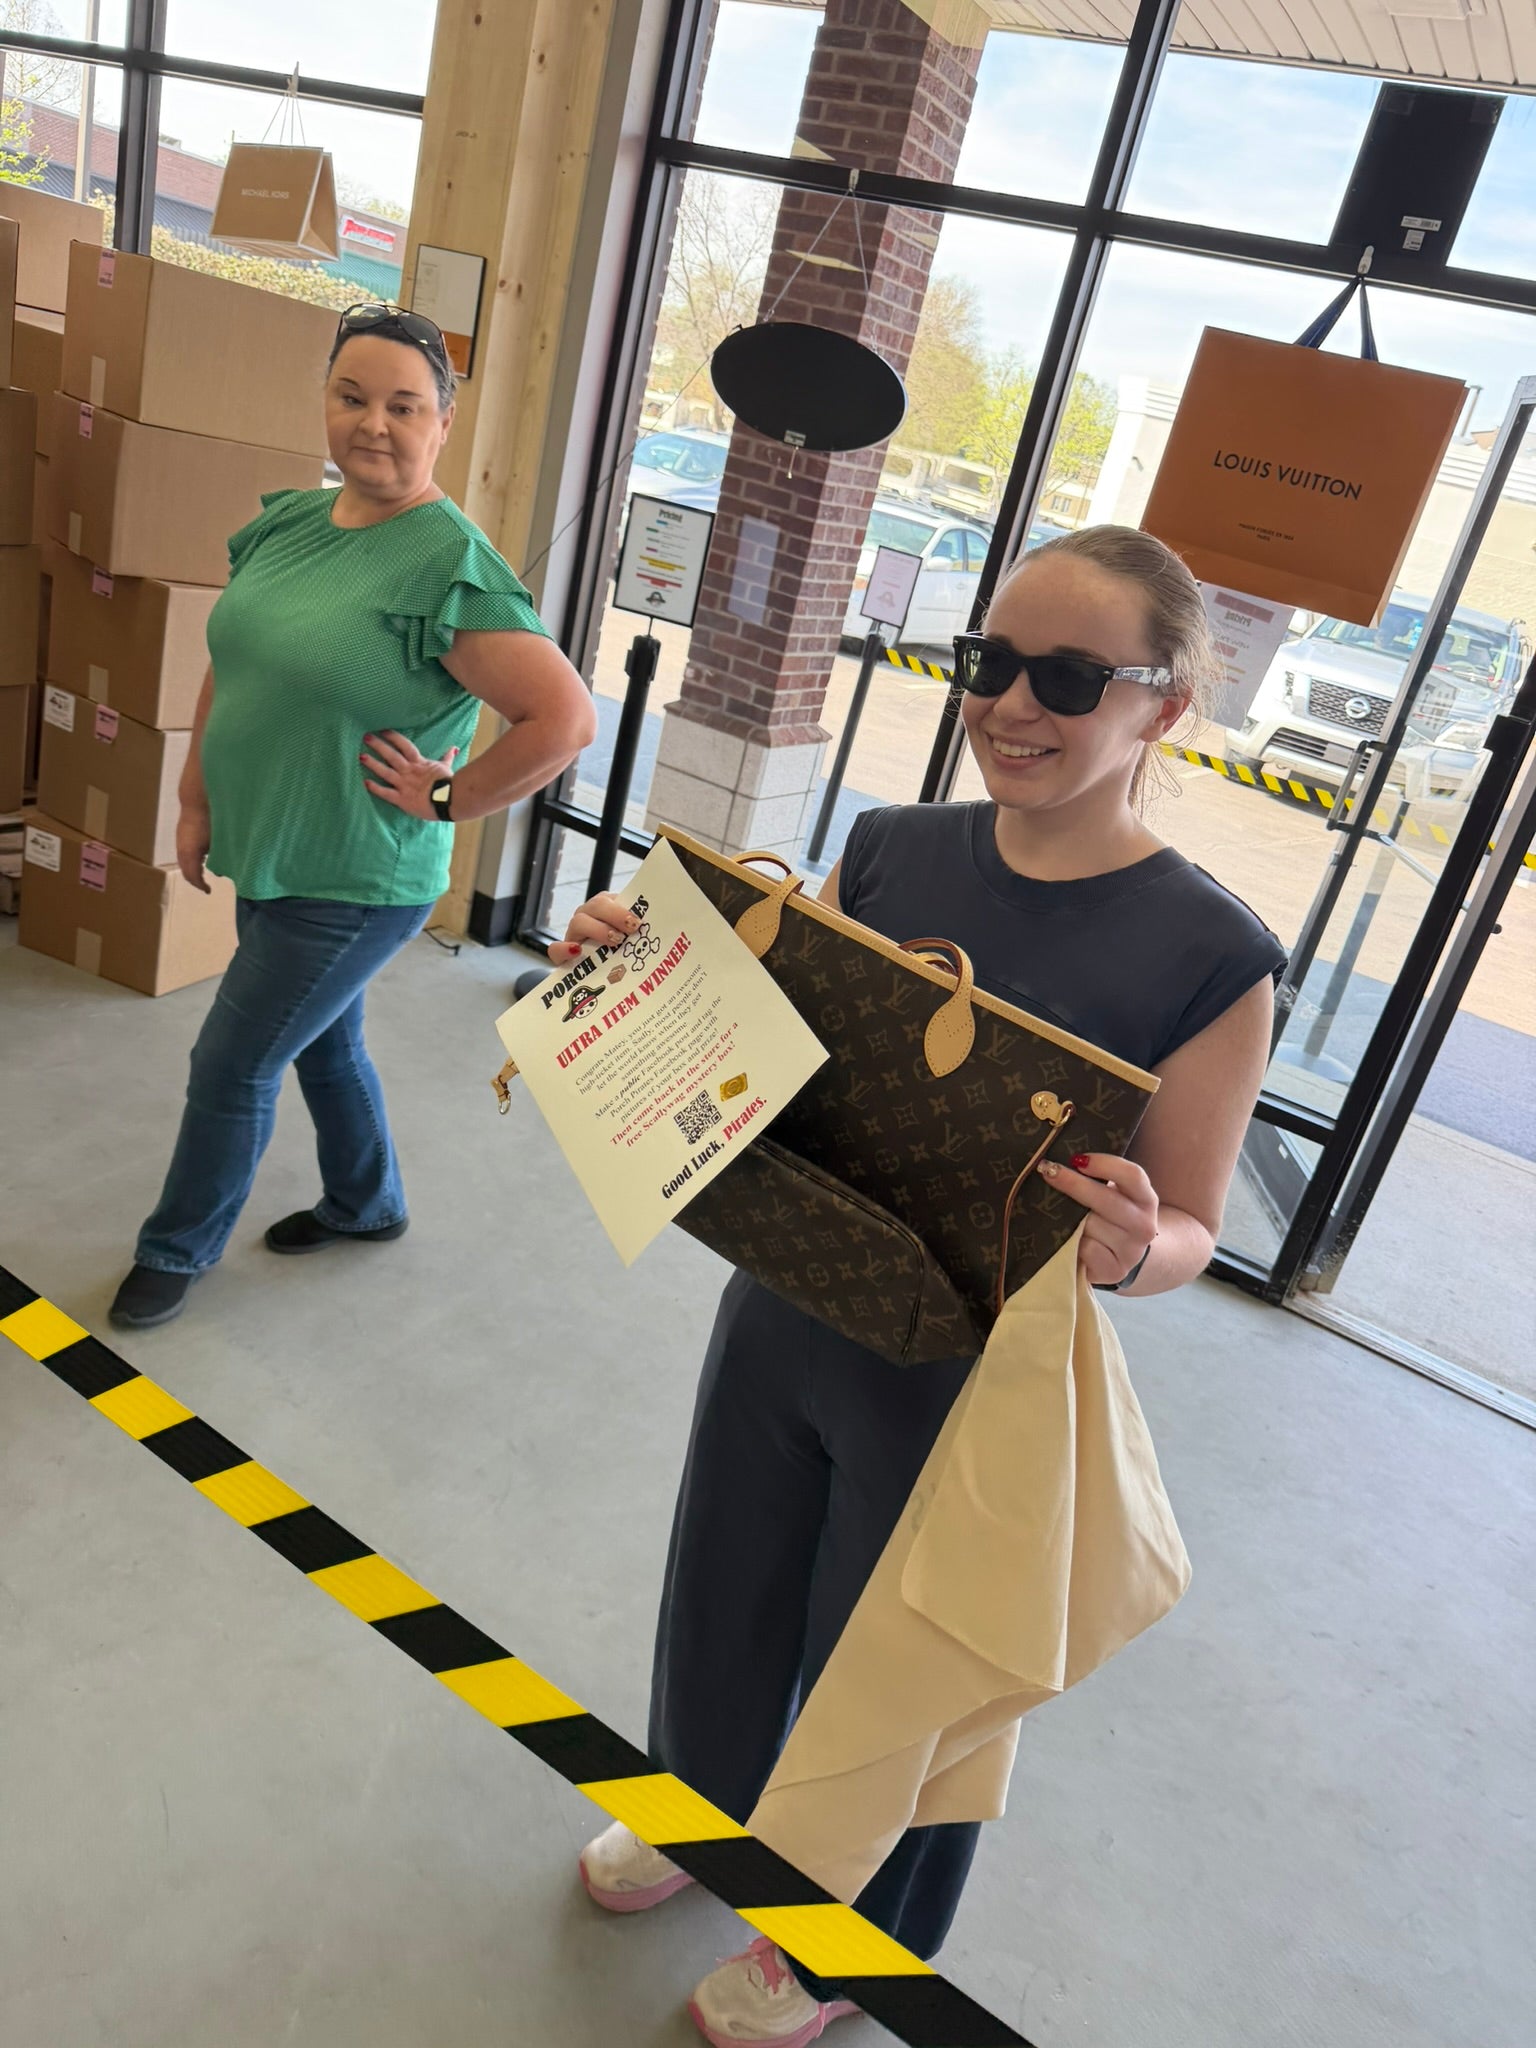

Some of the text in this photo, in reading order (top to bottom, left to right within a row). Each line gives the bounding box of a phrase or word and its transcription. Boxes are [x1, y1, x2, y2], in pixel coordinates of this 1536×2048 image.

[1213, 450, 1363, 501] LOUIS VUITTON
[540, 955, 597, 1009] PORCH
[555, 931, 691, 1069] ULTRA ITEM WINNER!
[574, 1058, 605, 1086] Congrats
[626, 1024, 642, 1040] you
[641, 1013, 656, 1030] just
[654, 1002, 668, 1017] got
[666, 994, 677, 1006] an
[675, 963, 702, 997] awesome
[653, 1010, 672, 1029] most
[670, 989, 692, 1015] people
[594, 1098, 614, 1117] Make
[613, 1093, 620, 1102] a
[618, 1073, 641, 1099] public
[639, 1045, 675, 1076] Facebook
[673, 1030, 690, 1049] post
[688, 1017, 703, 1034] and
[710, 994, 721, 1009] the
[595, 1079, 607, 1091] let
[605, 1069, 618, 1082] the
[616, 1050, 639, 1071] world
[636, 1034, 657, 1054] know
[657, 1018, 678, 1036] when
[675, 1005, 691, 1020] they
[609, 1014, 718, 1118] Porch Pirates Facebook page with
[609, 1021, 739, 1145] Then come back in the store for a
[619, 1095, 647, 1124] pictures
[646, 1084, 660, 1097] of
[654, 1072, 672, 1091] your
[670, 1061, 687, 1075] box
[686, 1046, 701, 1063] and
[620, 1021, 688, 1081] something awesome
[625, 1039, 736, 1147] free Scallywag mystery box!
[661, 1095, 767, 1199] Good Luck, Pirates.
